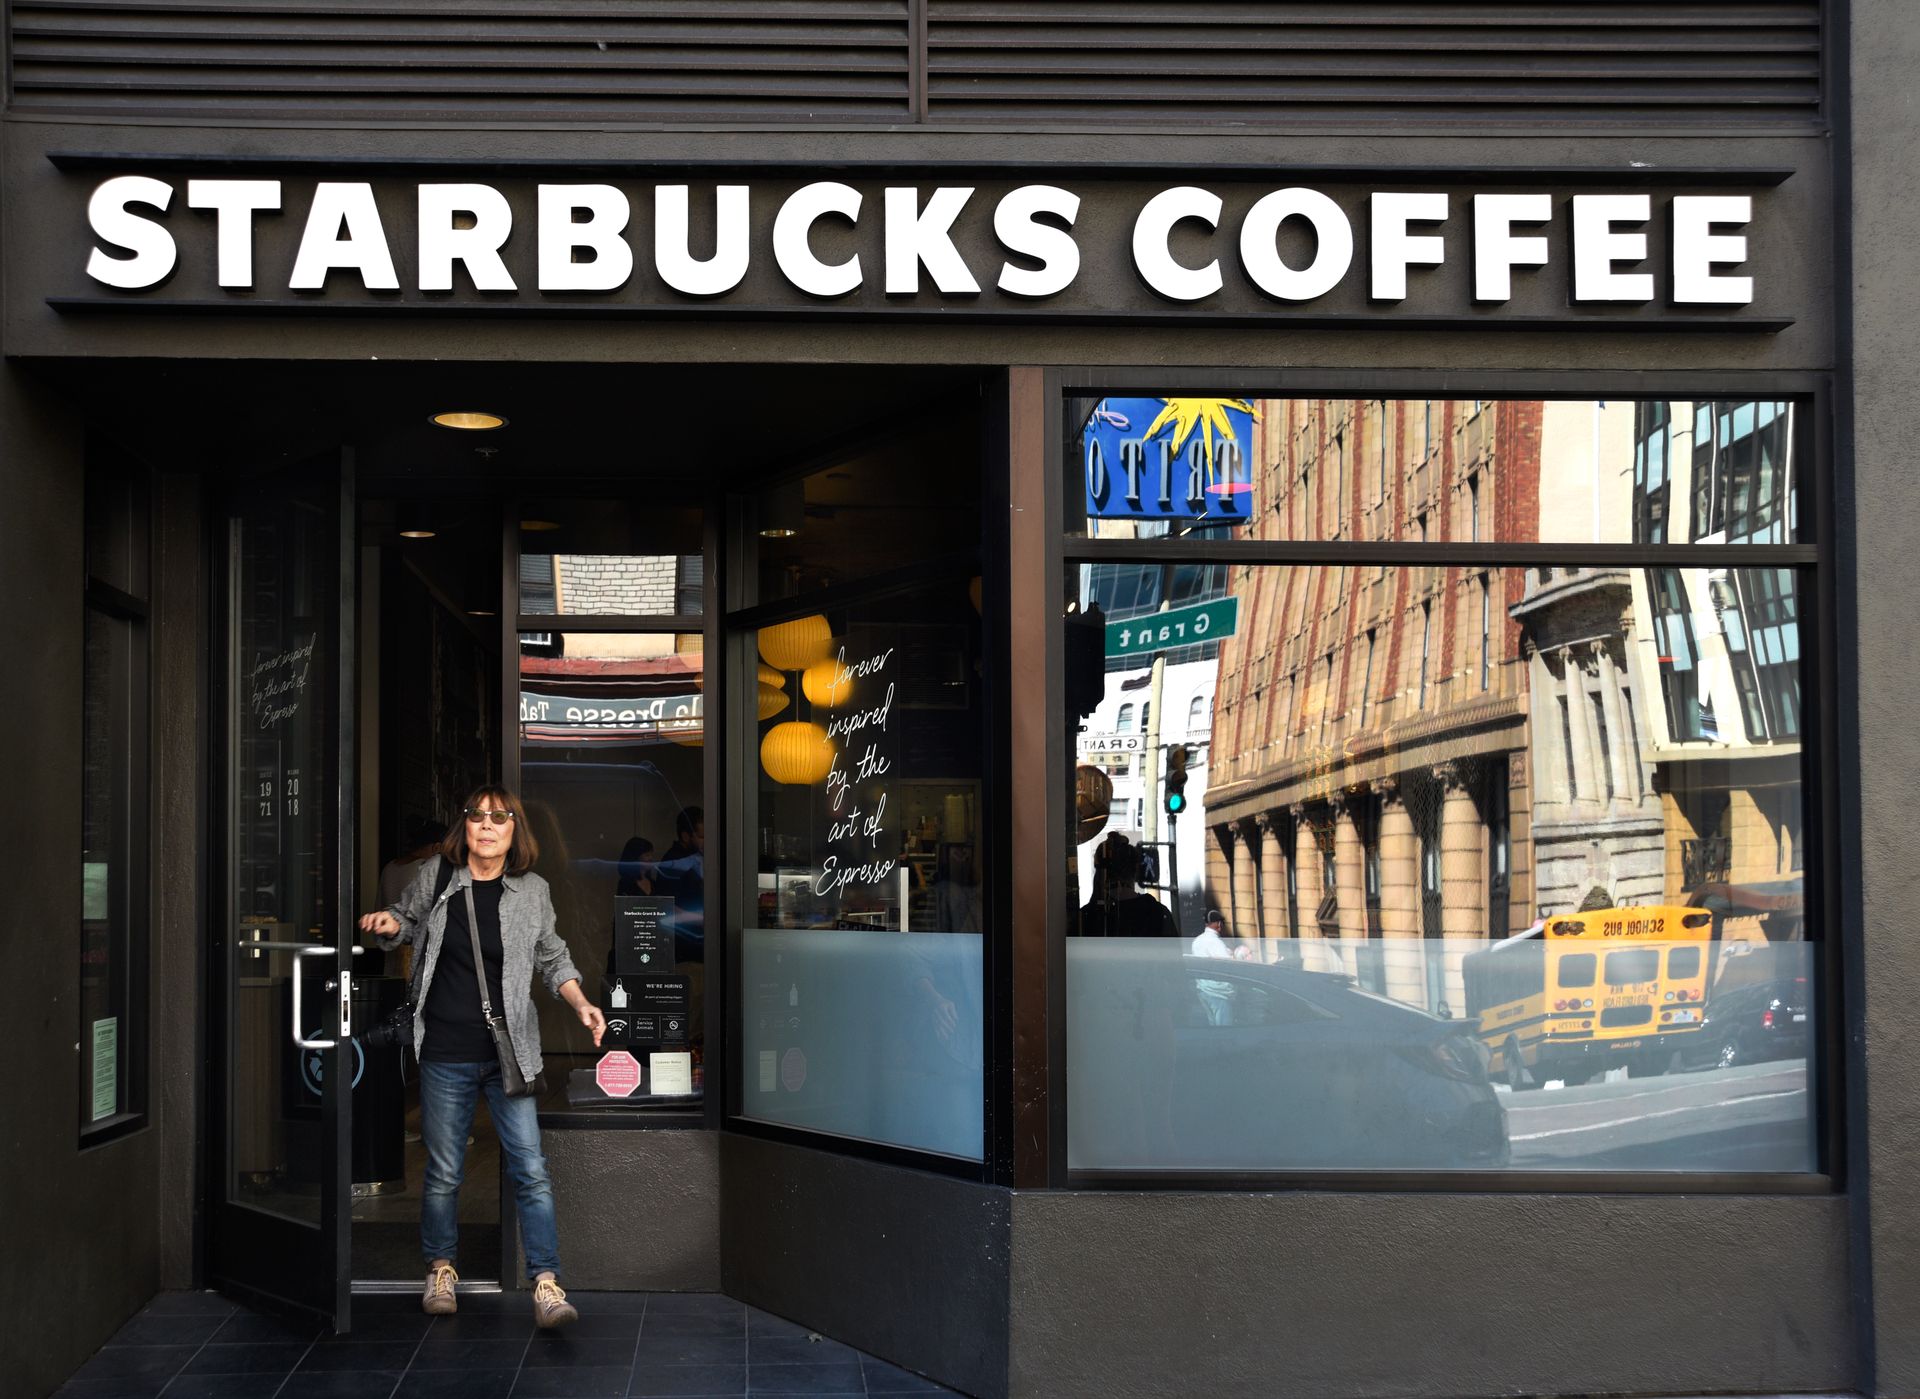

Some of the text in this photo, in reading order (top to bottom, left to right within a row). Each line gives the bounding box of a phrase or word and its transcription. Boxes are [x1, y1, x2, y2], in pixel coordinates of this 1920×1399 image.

[87, 177, 1752, 303] STARBUCKS COFFEE
[827, 645, 894, 707] forever
[824, 682, 894, 747] inspired
[260, 781, 272, 797] 19
[287, 778, 299, 796] 20
[826, 743, 891, 811] by the
[260, 801, 272, 816] 71
[287, 799, 299, 816] 18
[828, 793, 887, 848] art of
[815, 855, 896, 899] Espresso
